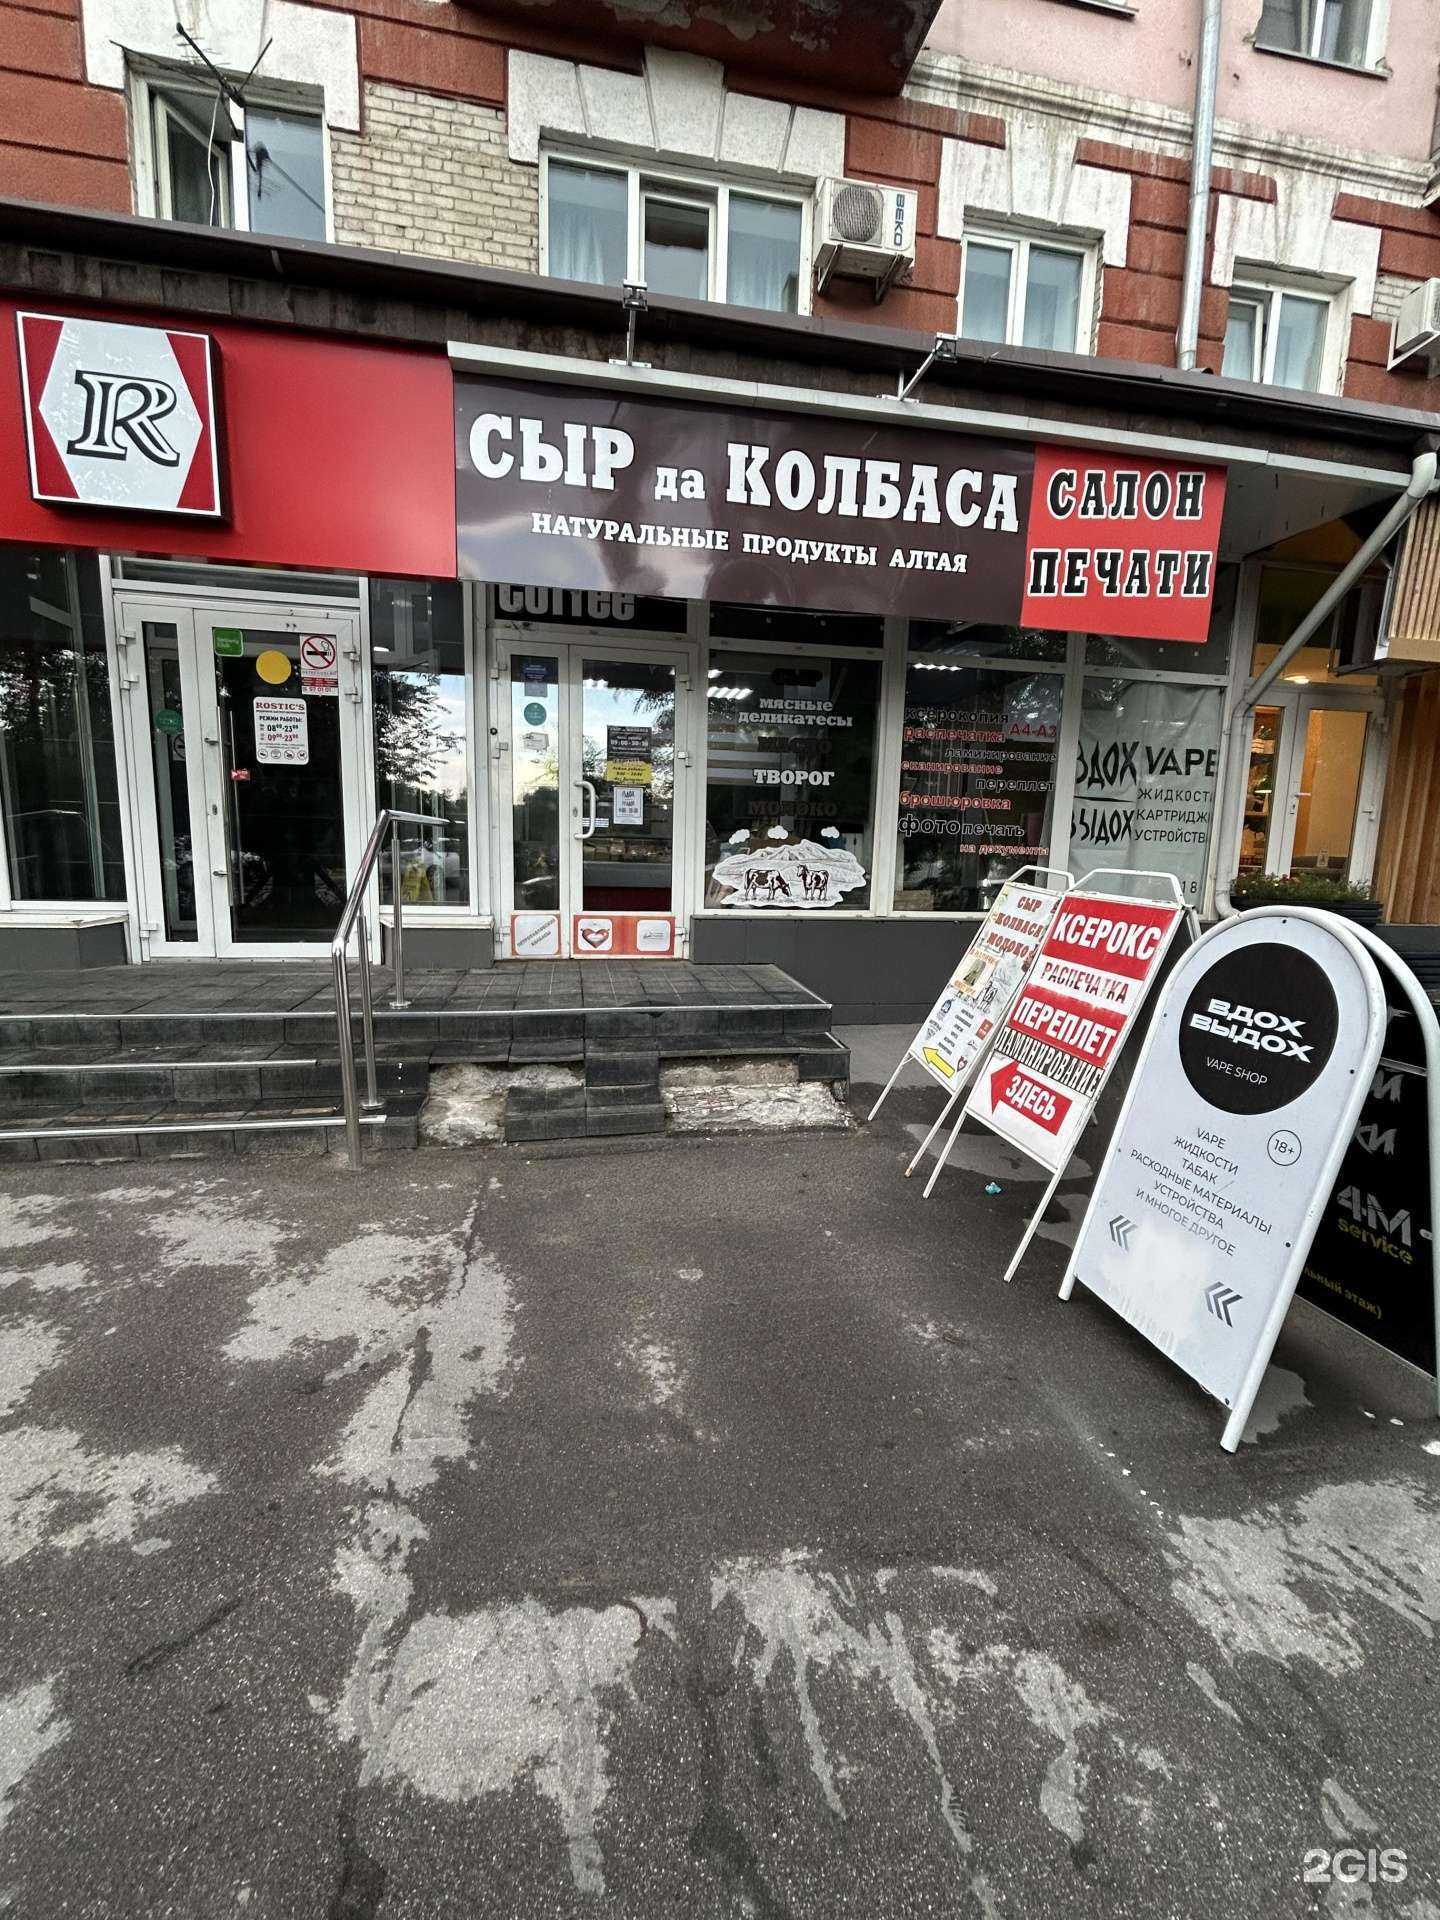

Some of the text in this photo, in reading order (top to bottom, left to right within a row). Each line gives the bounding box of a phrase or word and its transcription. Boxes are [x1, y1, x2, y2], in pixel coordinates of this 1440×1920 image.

[894, 193, 905, 246] BEKO
[66, 369, 181, 467] R
[469, 413, 1020, 533] СЫР да КОЛБАСА
[1047, 468, 1206, 521] САЛОН
[531, 511, 968, 574] НАТУРАЛЬНЫЕ ПРОДУКТЫ АЛТАЯ
[1027, 547, 1213, 598] ПЕЧАТИ
[255, 702, 305, 711] ROSTIC'S
[738, 711, 853, 727] деликатесы
[759, 698, 833, 712] мясные
[904, 707, 1009, 724] ксерокопия
[904, 726, 1007, 743] распечатка
[753, 769, 835, 786] ТВОРОГ
[900, 761, 1004, 774] сканирование
[1145, 745, 1217, 777] VAPE
[899, 790, 1012, 811] брошюровка
[959, 843, 977, 853] на
[978, 843, 1050, 856] документы
[1017, 896, 1043, 912] СЫР
[1052, 912, 1162, 961] КСЕРОКС
[1040, 962, 1131, 1005] РАСПЕЧАТКА
[1013, 996, 1119, 1058] ПЕРЕПЛЕТ
[1189, 1013, 1315, 1064] ВЫДОХ
[1208, 998, 1307, 1039] ВДОХ
[995, 1026, 1105, 1099] ЛАМИНИРОВАНИЕ
[1206, 1056, 1268, 1085] VAPE SHOP
[1005, 1075, 1057, 1121] ЗДЕСЬ
[1174, 1135, 1239, 1175] ЖИДКОСТИ
[1197, 1127, 1227, 1149] VAPE
[1274, 1138, 1295, 1155] 18+
[1182, 1158, 1219, 1185] ТАБАК
[1130, 1149, 1273, 1235] РАСХОДНЫЕ МАТЕРИАЛЫ
[1153, 1179, 1225, 1229] УСТРОЙСТВА
[1136, 1187, 1237, 1257] И МНОГОЕ ДРУГОЕ
[1337, 1218, 1414, 1265] service
